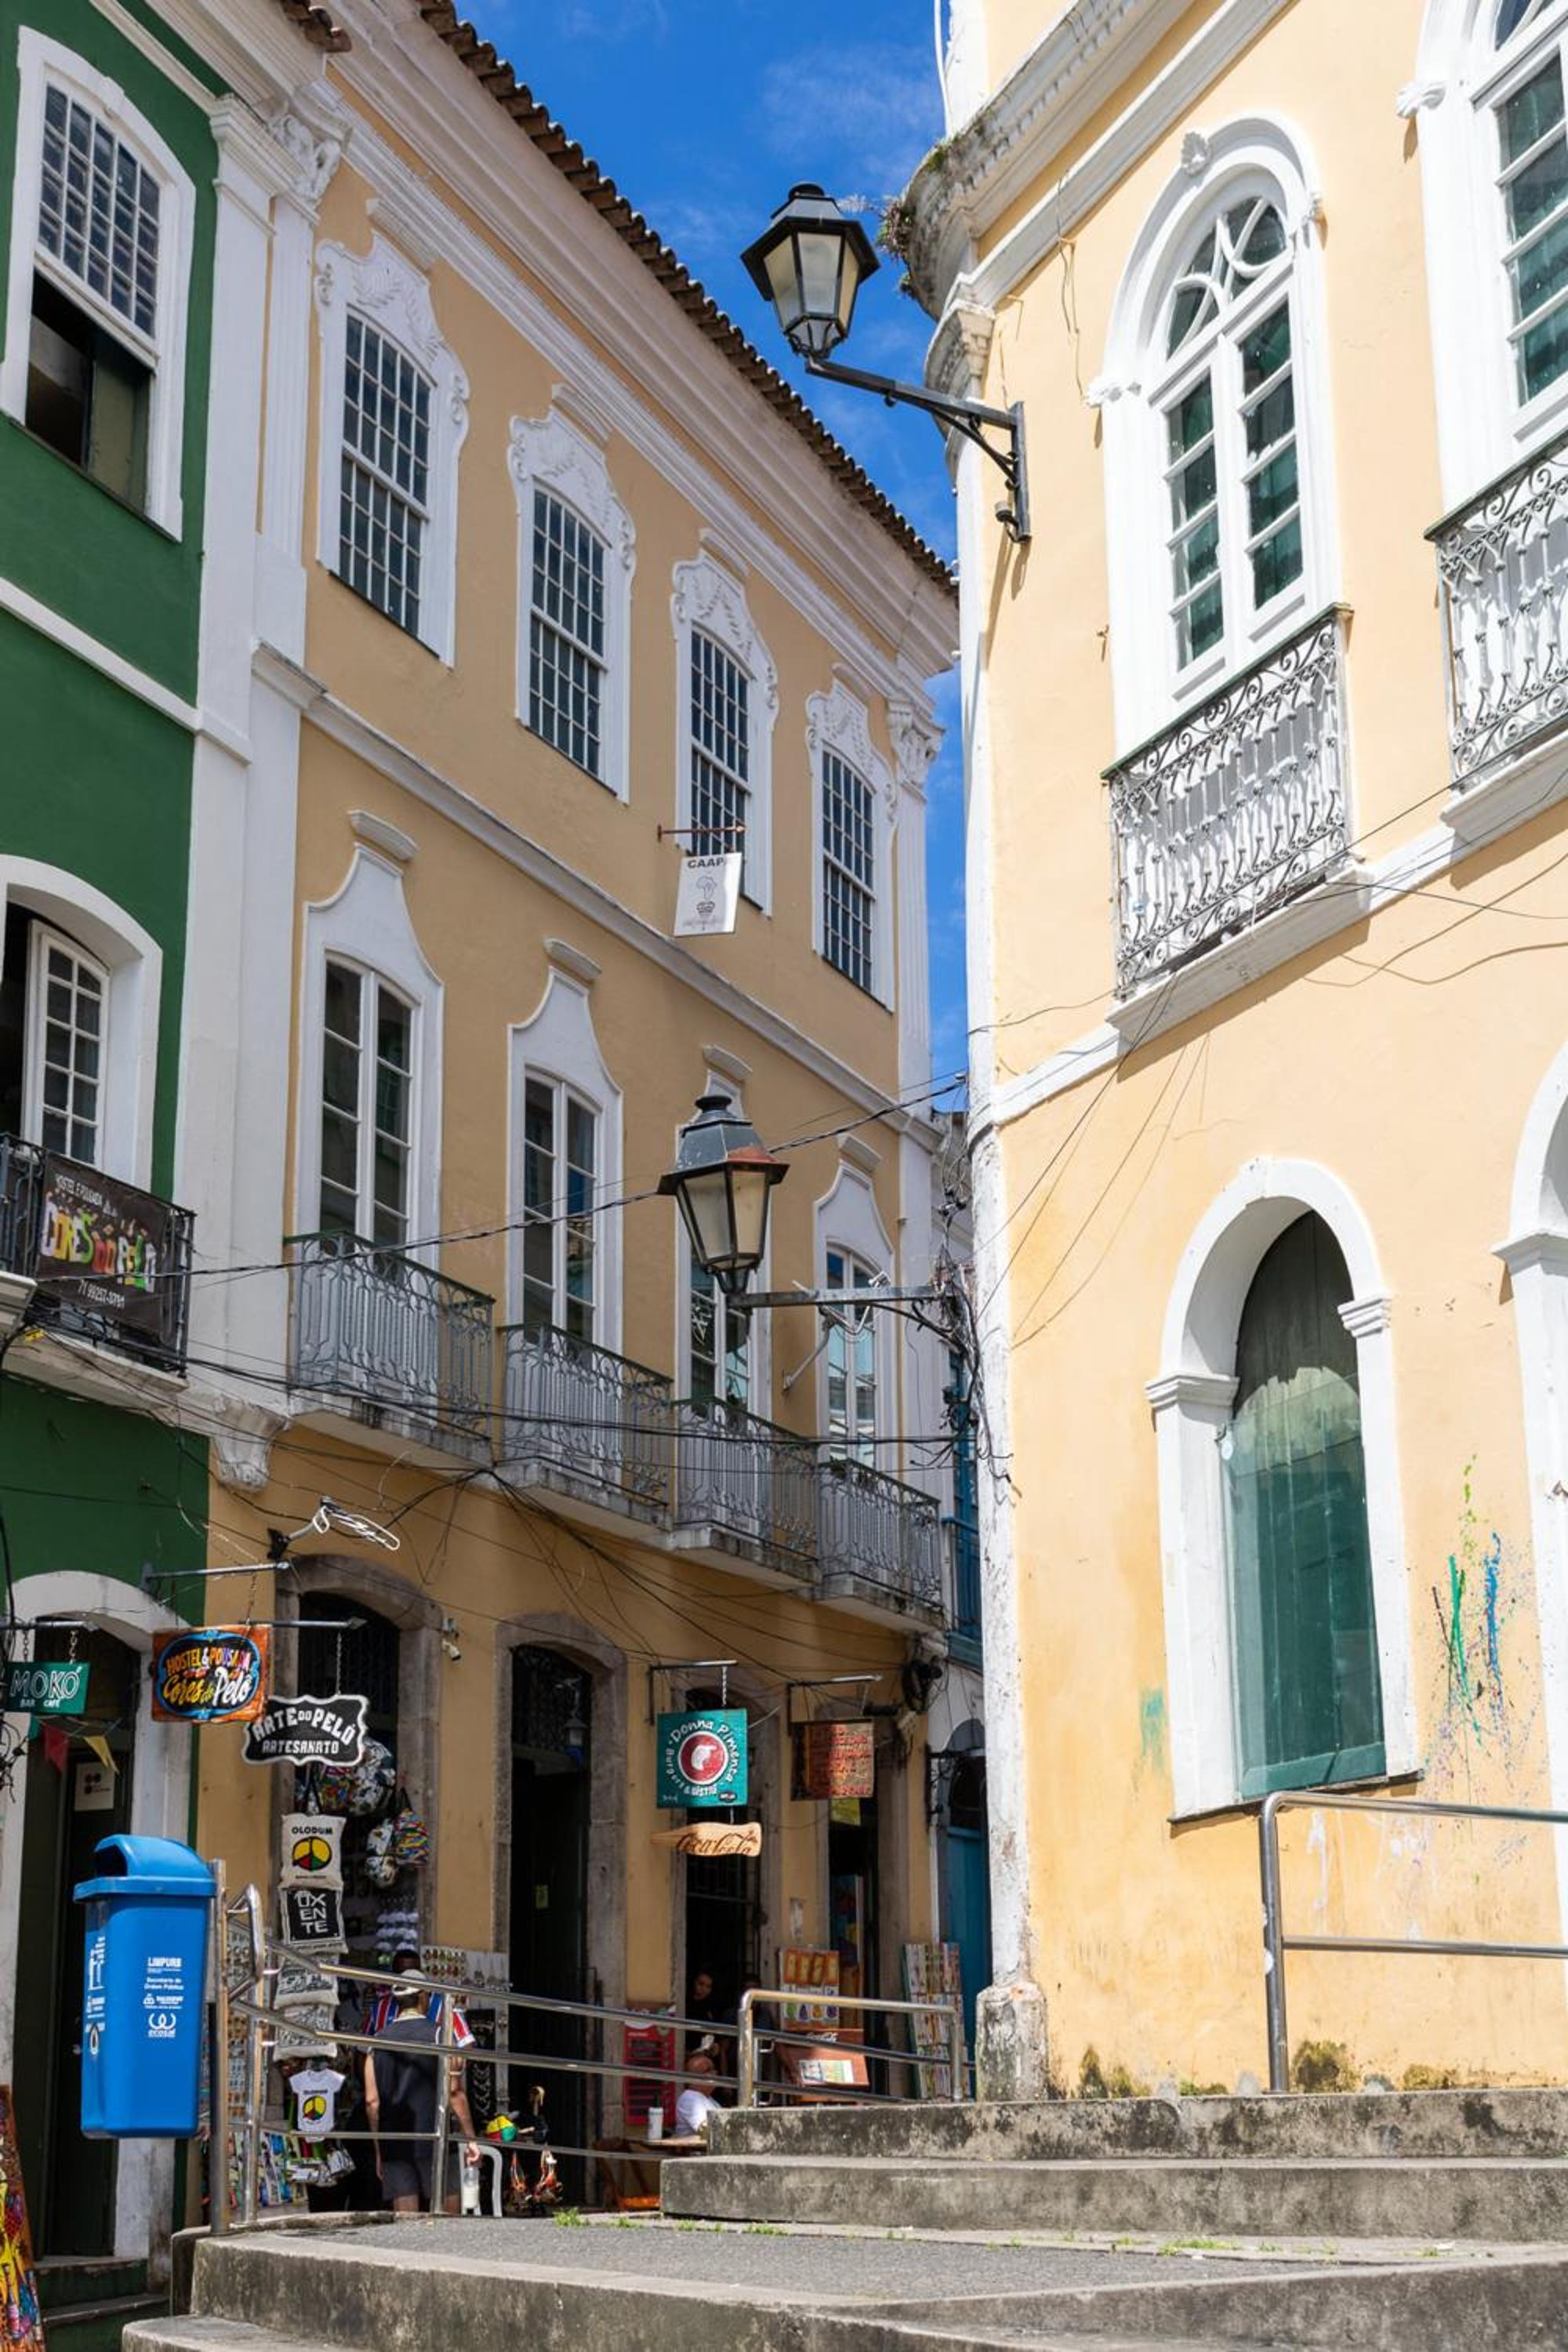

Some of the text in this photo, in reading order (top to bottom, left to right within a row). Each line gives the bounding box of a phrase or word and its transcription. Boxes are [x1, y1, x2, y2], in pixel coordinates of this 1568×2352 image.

[165, 1647, 201, 1676] HOSTEL
[209, 1646, 252, 1672] POUSADA
[163, 1674, 204, 1705] Cores
[20, 1699, 35, 1708] BAR
[252, 1707, 298, 1742] ARTE
[297, 1710, 312, 1721] DO
[262, 1740, 339, 1754] ARTESANATO
[670, 1719, 739, 1783] Donna Pimenta
[292, 1826, 332, 1835] OLODUM
[299, 1908, 326, 1921] EN
[301, 1921, 328, 1934] TE
